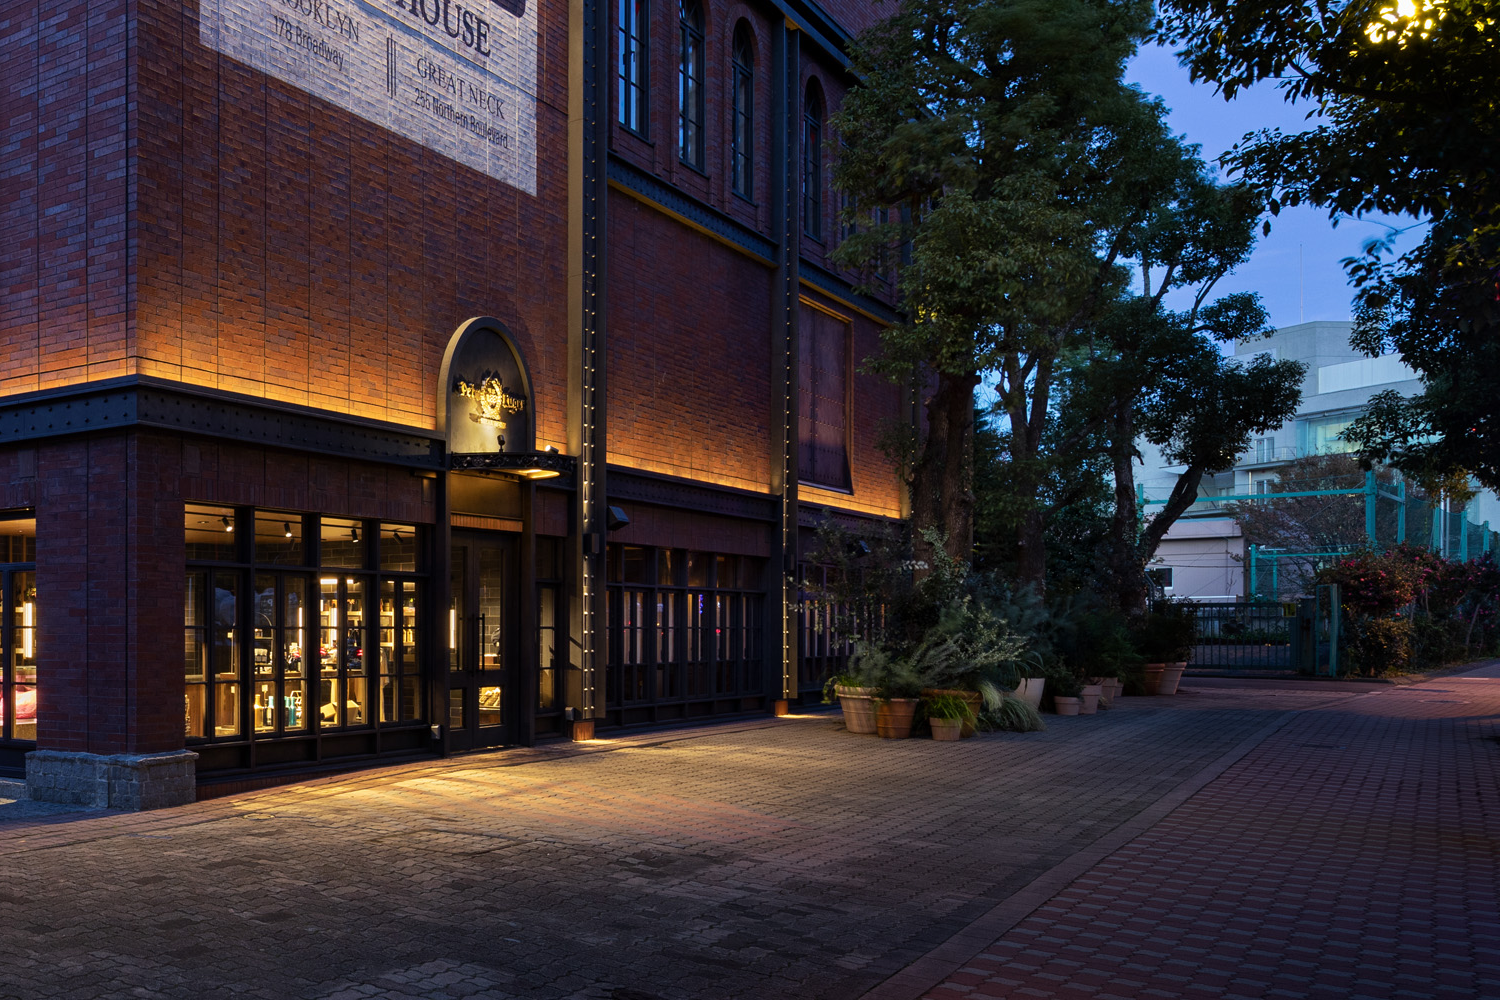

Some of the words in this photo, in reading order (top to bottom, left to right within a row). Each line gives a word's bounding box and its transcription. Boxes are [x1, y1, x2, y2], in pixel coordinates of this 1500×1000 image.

[273, 15, 293, 42] 178
[295, 25, 344, 72] Broadway
[414, 87, 431, 111] 255
[432, 96, 469, 131] Northern
[470, 114, 509, 149] Boulevard
[416, 57, 466, 98] GREAT
[468, 84, 506, 120] NECK
